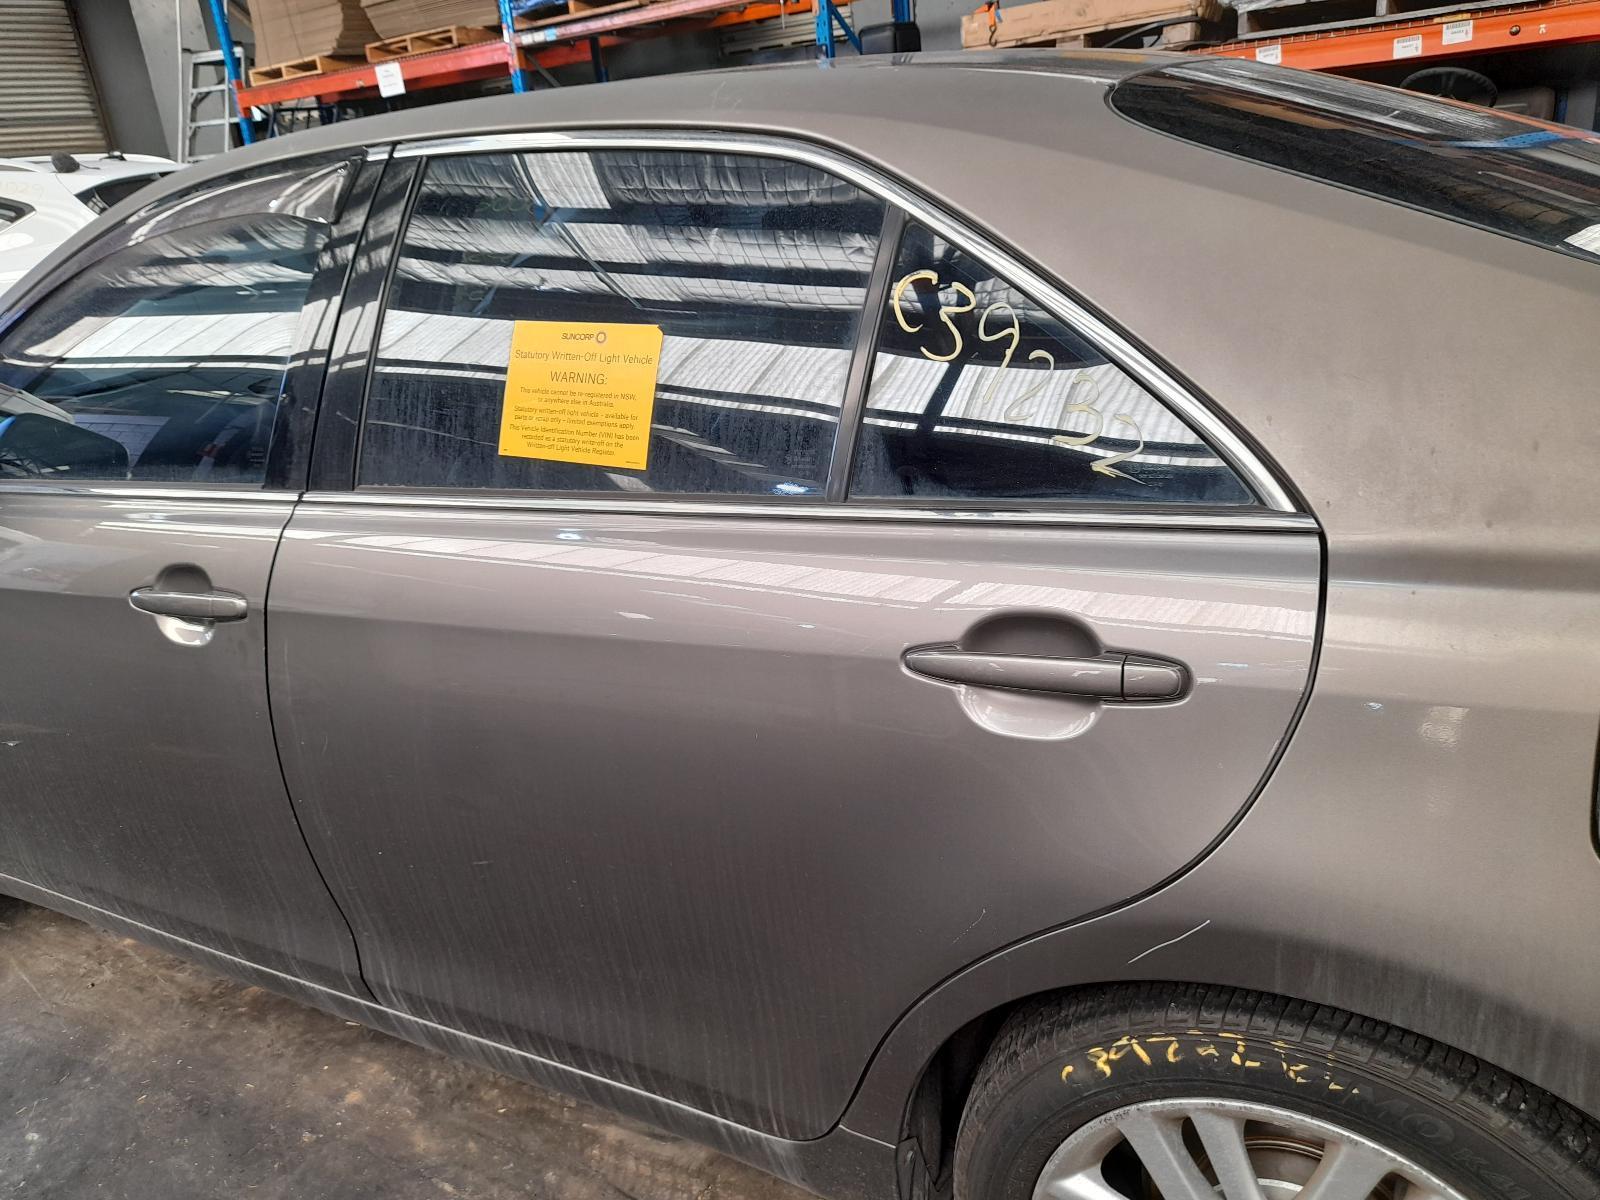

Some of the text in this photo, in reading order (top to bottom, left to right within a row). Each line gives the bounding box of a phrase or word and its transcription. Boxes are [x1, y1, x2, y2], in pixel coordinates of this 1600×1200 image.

[561, 332, 594, 341] SUNCORP
[515, 349, 653, 365] Statutory Written-Off Light Vehicle
[550, 370, 608, 385] WARNING:
[531, 387, 549, 395] vehicle
[514, 406, 537, 414] Statutory
[566, 409, 578, 417] light
[580, 410, 599, 418] vehicle
[605, 412, 629, 421] available
[514, 414, 528, 422] parts
[550, 417, 561, 425] only
[587, 419, 618, 428] exemptions
[509, 423, 520, 431] This
[520, 424, 539, 432] Vehicle
[540, 426, 575, 436] Identification
[575, 429, 598, 438] Number
[598, 431, 614, 439] (VIN)
[614, 432, 624, 440] has
[555, 443, 570, 453] Light
[571, 445, 591, 454] Vehicle
[556, 437, 580, 447] statutory
[614, 441, 624, 449] the
